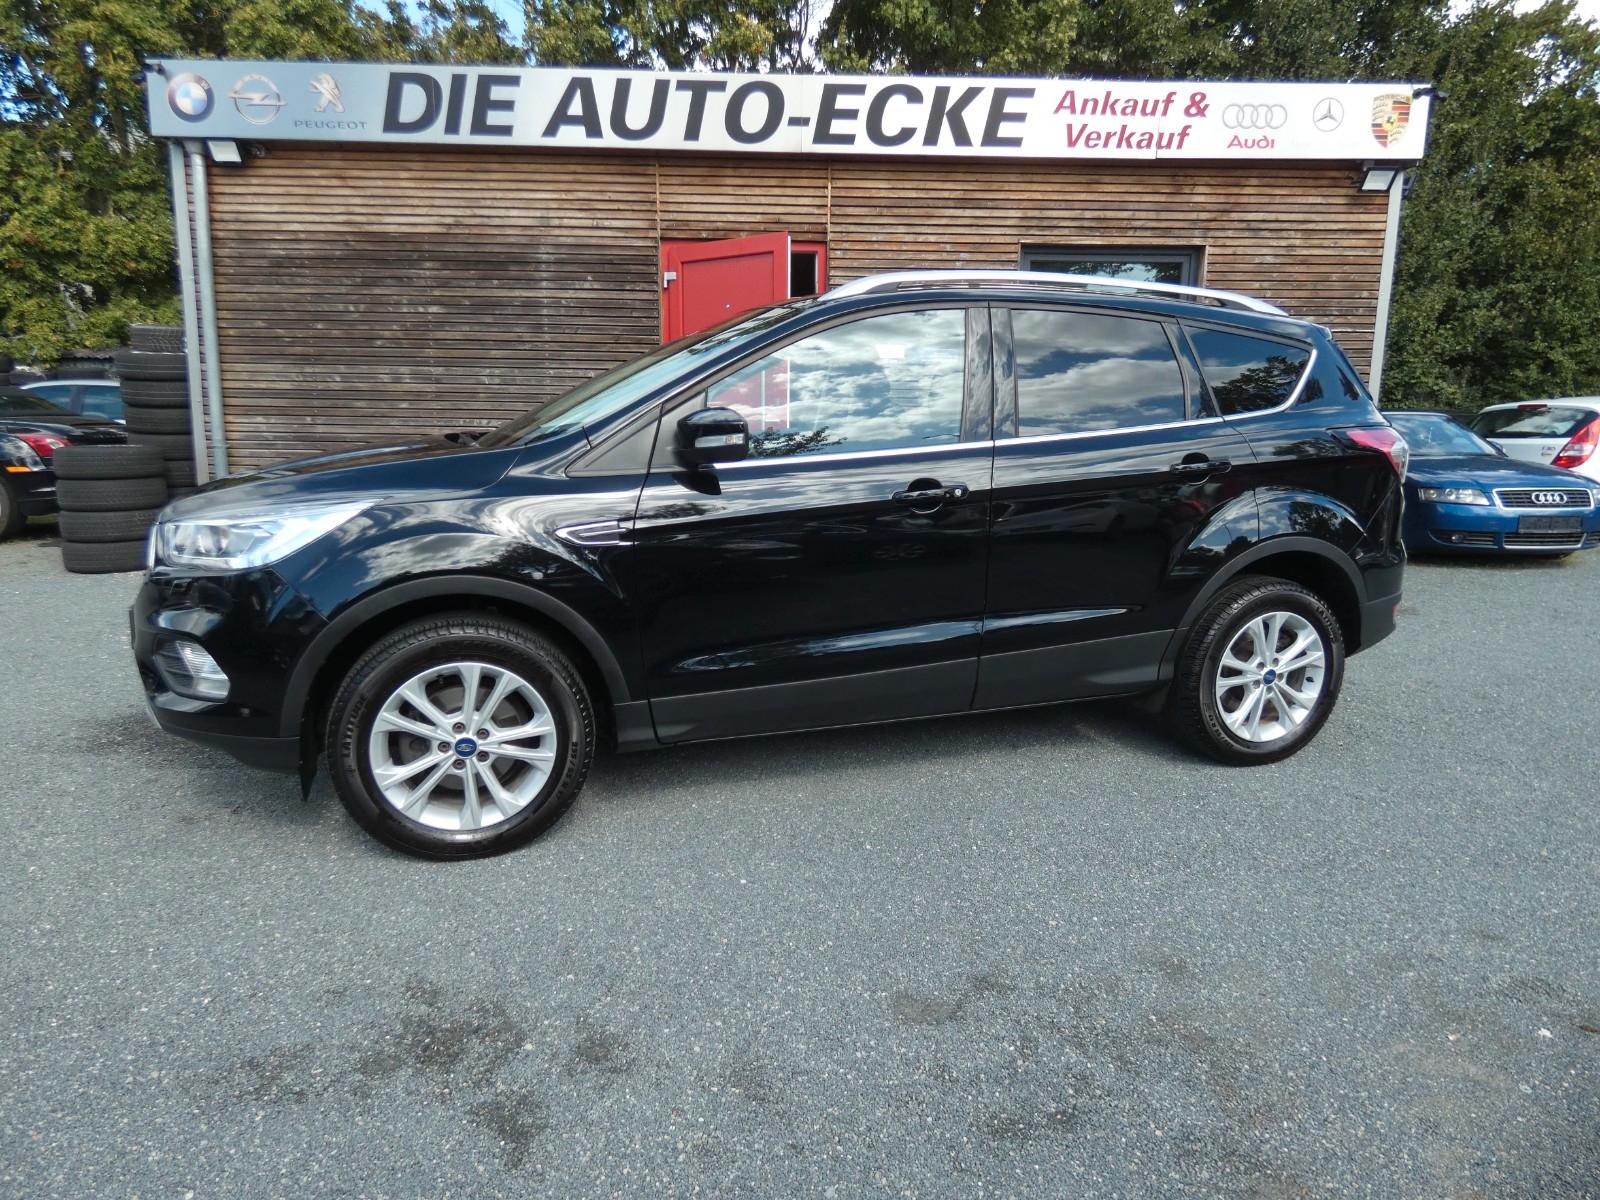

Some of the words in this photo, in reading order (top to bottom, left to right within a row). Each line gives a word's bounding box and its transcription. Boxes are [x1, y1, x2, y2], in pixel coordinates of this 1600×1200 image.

[382, 71, 523, 138] DIE
[541, 76, 1036, 148] AUTO-ECKE
[1053, 89, 1177, 118] Ankauf
[1183, 91, 1210, 119] &
[293, 119, 368, 129] PEUGEOT
[1065, 123, 1192, 151] Verkauf
[1227, 135, 1275, 150] Audi
